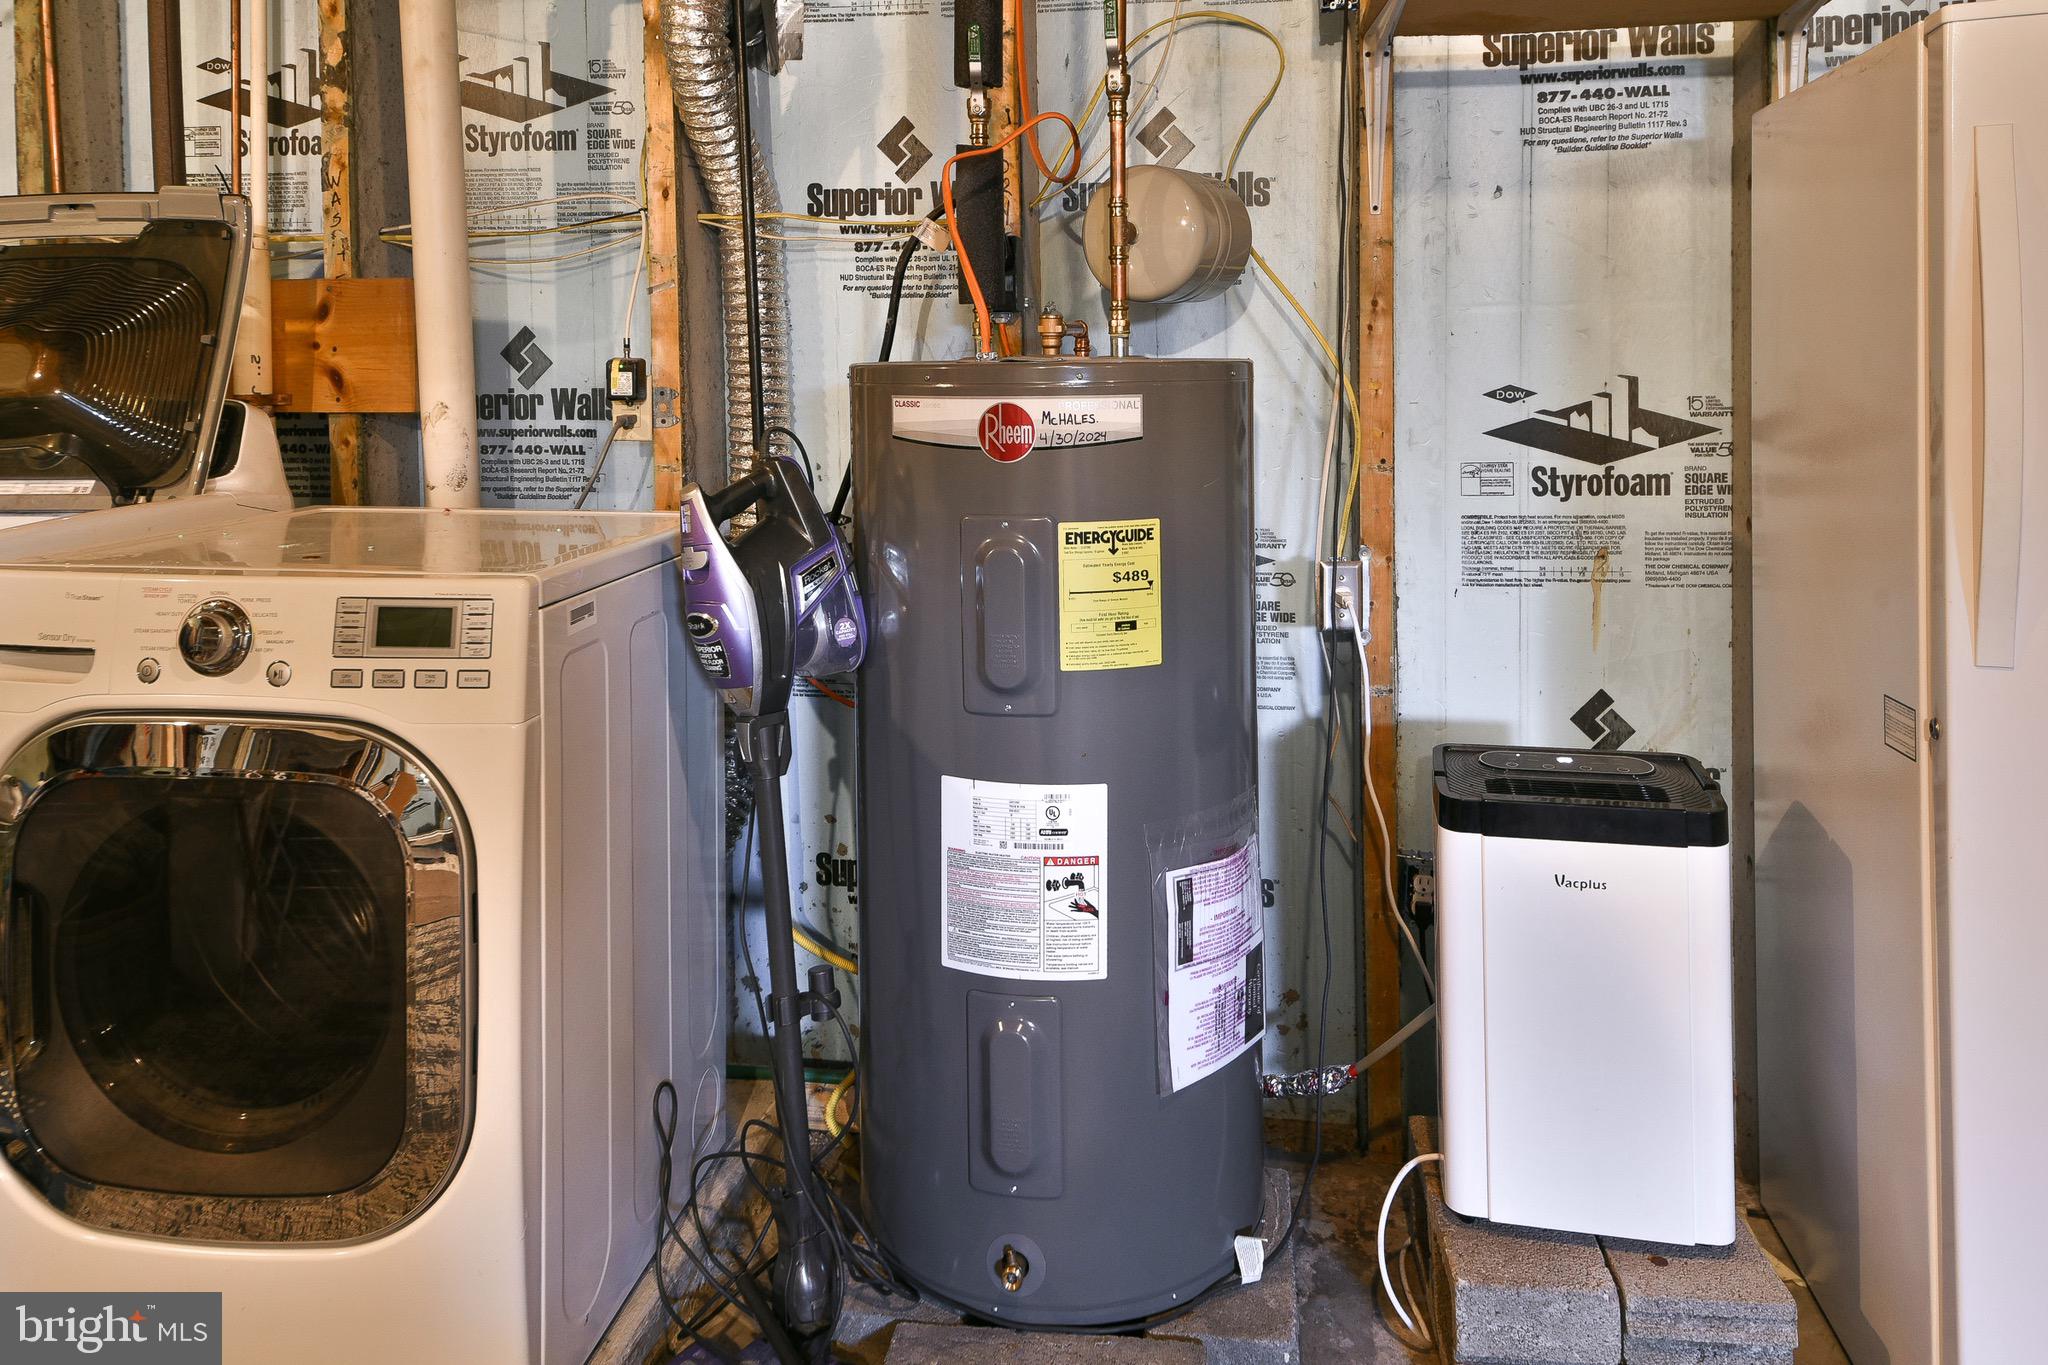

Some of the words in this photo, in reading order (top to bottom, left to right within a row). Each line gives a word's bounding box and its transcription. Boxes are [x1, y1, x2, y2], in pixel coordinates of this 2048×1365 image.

[1807, 6, 1929, 53] uperior
[1483, 29, 1617, 71] Superior
[588, 60, 601, 73] 15
[1520, 63, 1685, 85] www.superiorwalls.com
[1537, 85, 1670, 103] 877-440-WALL
[1538, 107, 1571, 115] Complies
[1573, 105, 1587, 113] with
[1589, 104, 1605, 112] UBC
[1607, 103, 1622, 111] 26-3
[1640, 101, 1650, 109] UL
[1539, 116, 1572, 124] BOCA-ES
[1575, 114, 1607, 123] Research
[1609, 113, 1633, 122] Report
[587, 129, 621, 139] SQUARE
[1520, 127, 1535, 135] HUD
[1538, 125, 1572, 134] Structural
[1574, 123, 1616, 133] Engineering
[1619, 121, 1646, 130] Bulletin
[587, 140, 610, 149] EDGE
[612, 139, 635, 149] WIDE
[1523, 139, 1535, 147] For
[1537, 139, 1550, 148] any
[1552, 136, 1588, 146] questions,
[1590, 135, 1607, 143] refer
[1631, 132, 1662, 142] Superior
[1664, 131, 1683, 139] Walls
[1585, 143, 1618, 153] Guideline
[807, 182, 922, 219] Superior
[1687, 396, 1703, 410] 15
[985, 402, 1033, 452] Rheem
[1039, 430, 1107, 447] 4/30/2024
[480, 445, 586, 455] 877-440-WALL
[481, 459, 508, 467] Complies
[538, 467, 557, 475] Report
[1685, 473, 1728, 485] SQUARE
[1685, 485, 1713, 495] EDGE
[1065, 528, 1154, 545] ENERGYGUIDE
[804, 562, 831, 585] Rocket
[1113, 569, 1149, 583] $489
[1270, 612, 1296, 623] WIDE
[38, 632, 62, 641] Sensor
[63, 634, 76, 642] Dry
[1555, 874, 1607, 891] Vacplus
